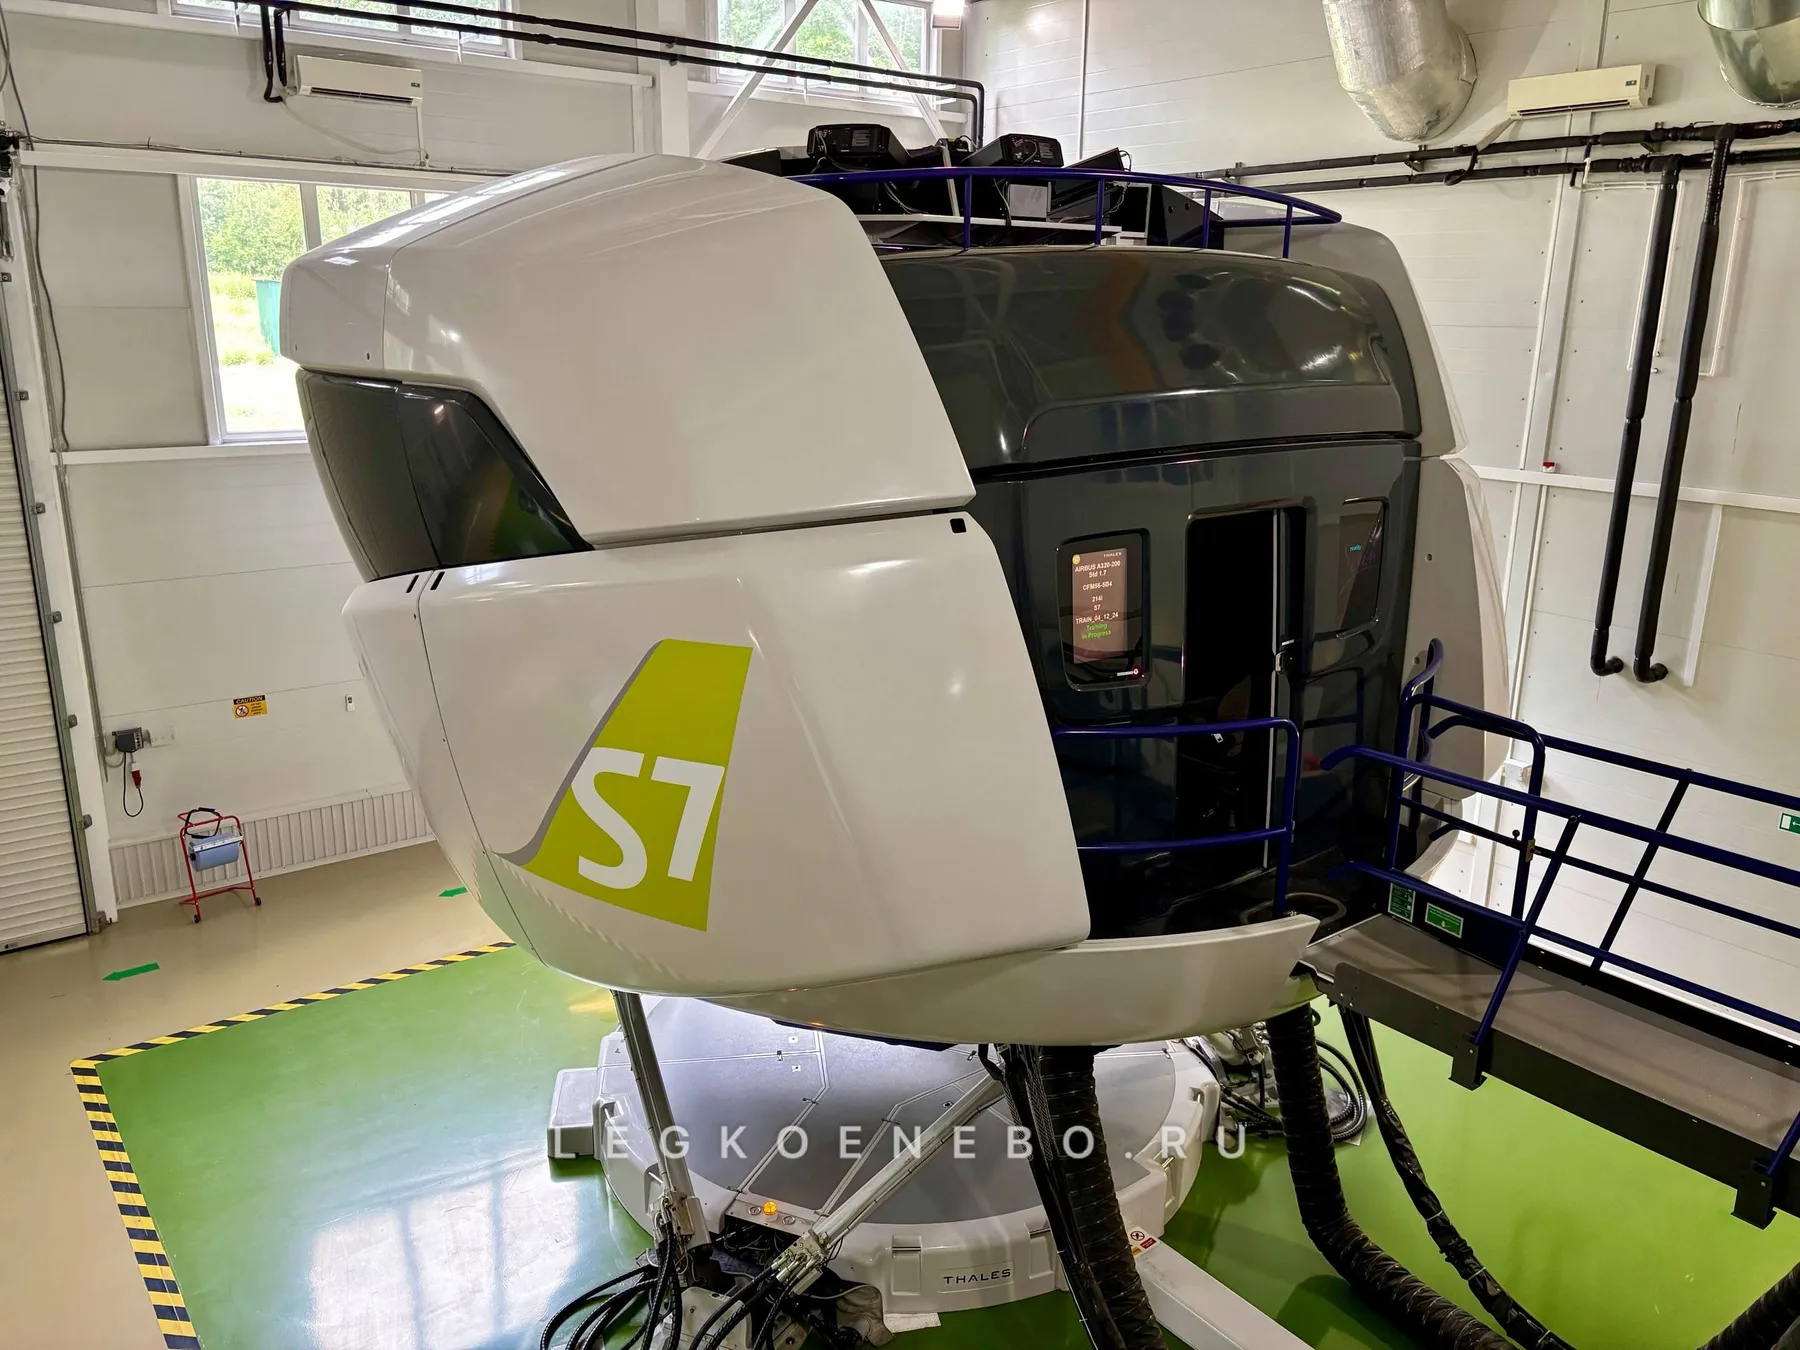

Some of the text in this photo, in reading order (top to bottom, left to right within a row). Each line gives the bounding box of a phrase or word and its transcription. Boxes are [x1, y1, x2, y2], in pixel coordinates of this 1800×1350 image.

[1075, 560, 1121, 573] AIRBUS A320-200
[1082, 581, 1113, 591] CFM56-5B4
[1075, 612, 1119, 625] TRAIN_04_12_24
[1087, 623, 1108, 631] Training
[1088, 630, 1112, 639] Progress
[236, 696, 262, 704] CAUTION
[571, 747, 725, 889] S7
[943, 1268, 1011, 1285] THALES
